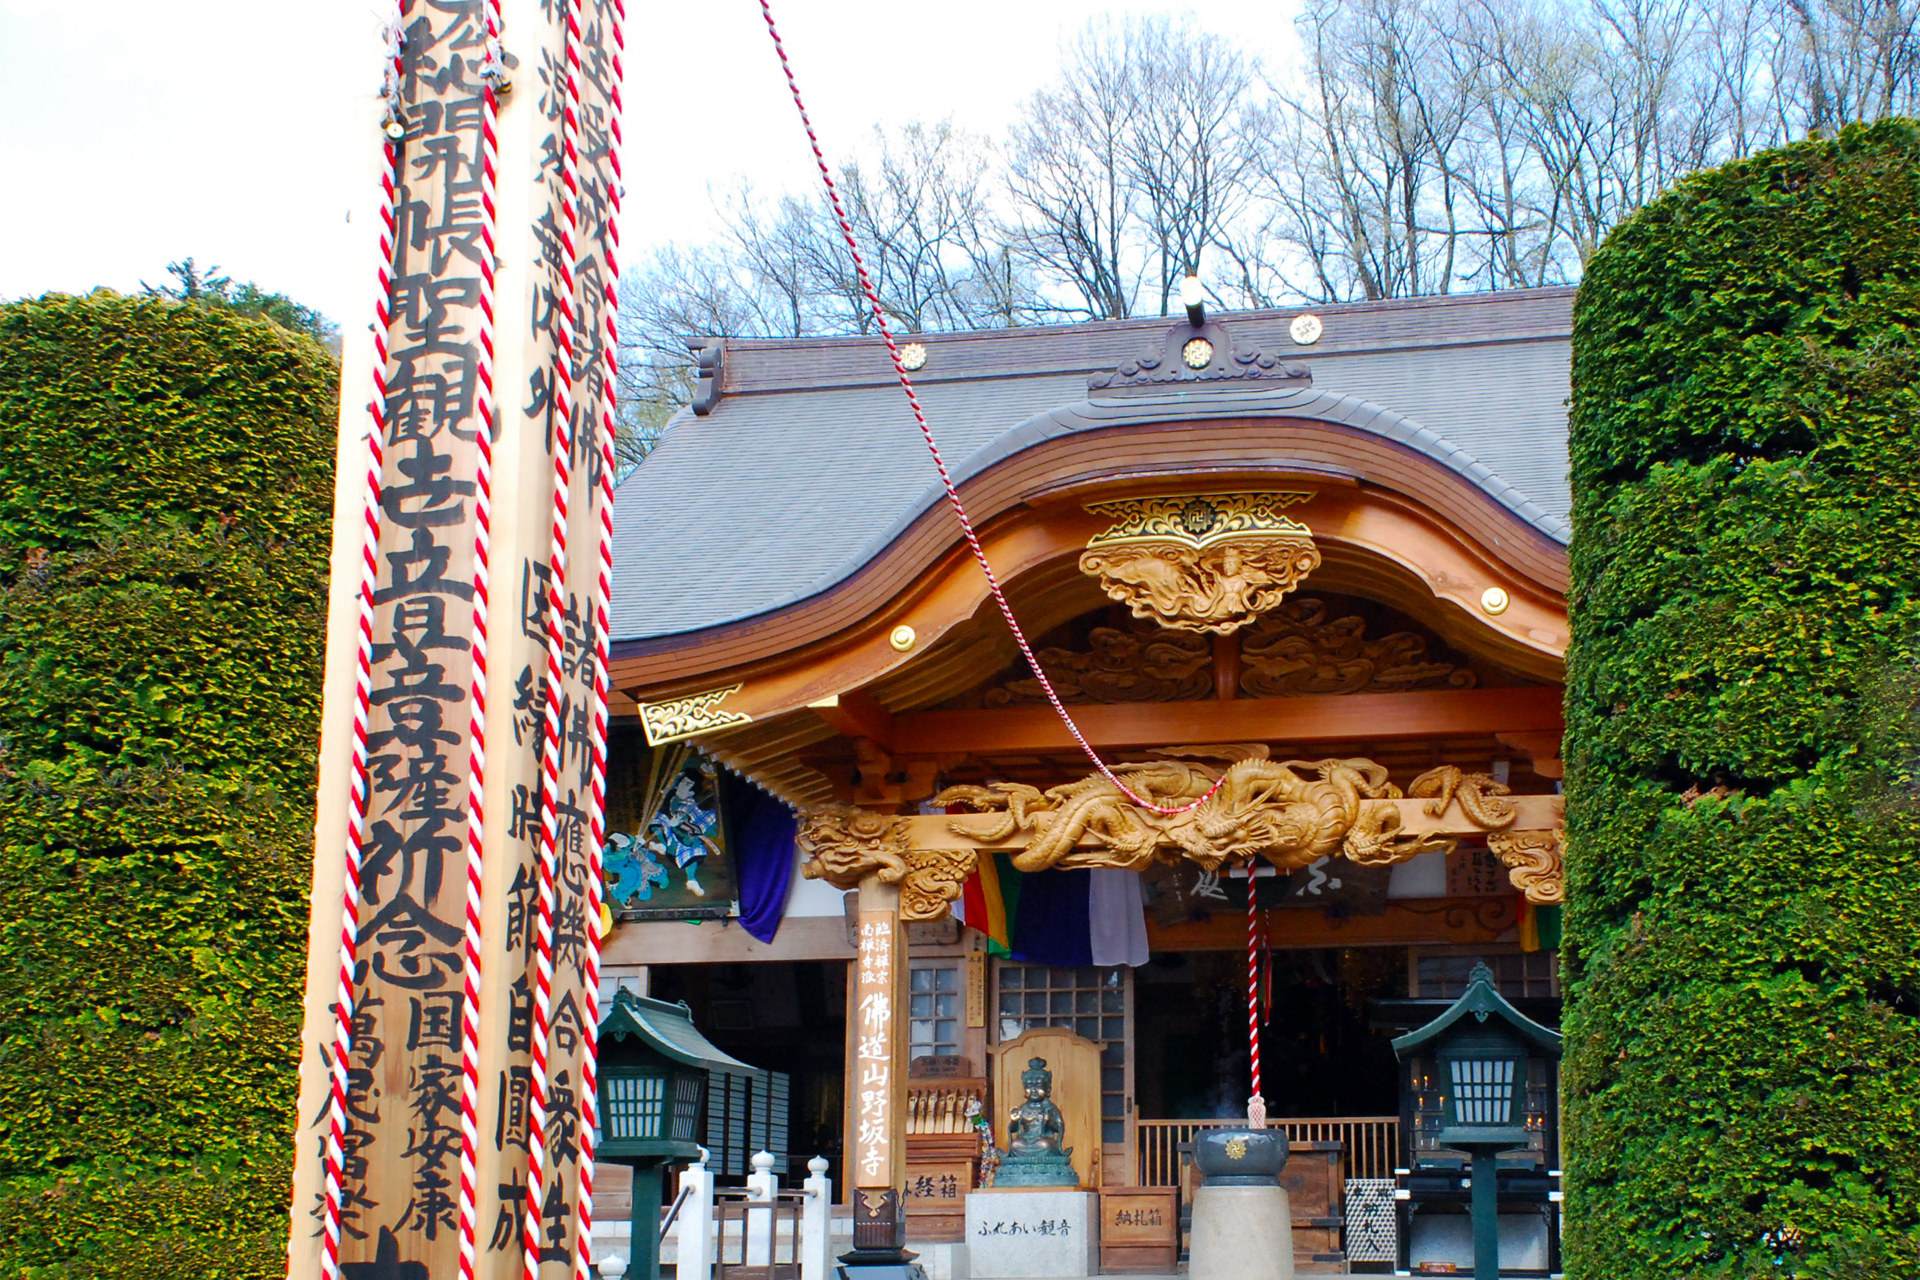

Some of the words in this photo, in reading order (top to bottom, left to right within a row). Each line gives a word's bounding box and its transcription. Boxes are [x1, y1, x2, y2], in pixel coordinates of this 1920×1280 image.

[393, 991, 465, 1241] 国家安康
[858, 992, 891, 1177] 佛道山野坂寺
[978, 1218, 1071, 1236] ふれあい観音
[1115, 1208, 1162, 1227] 納札箱
